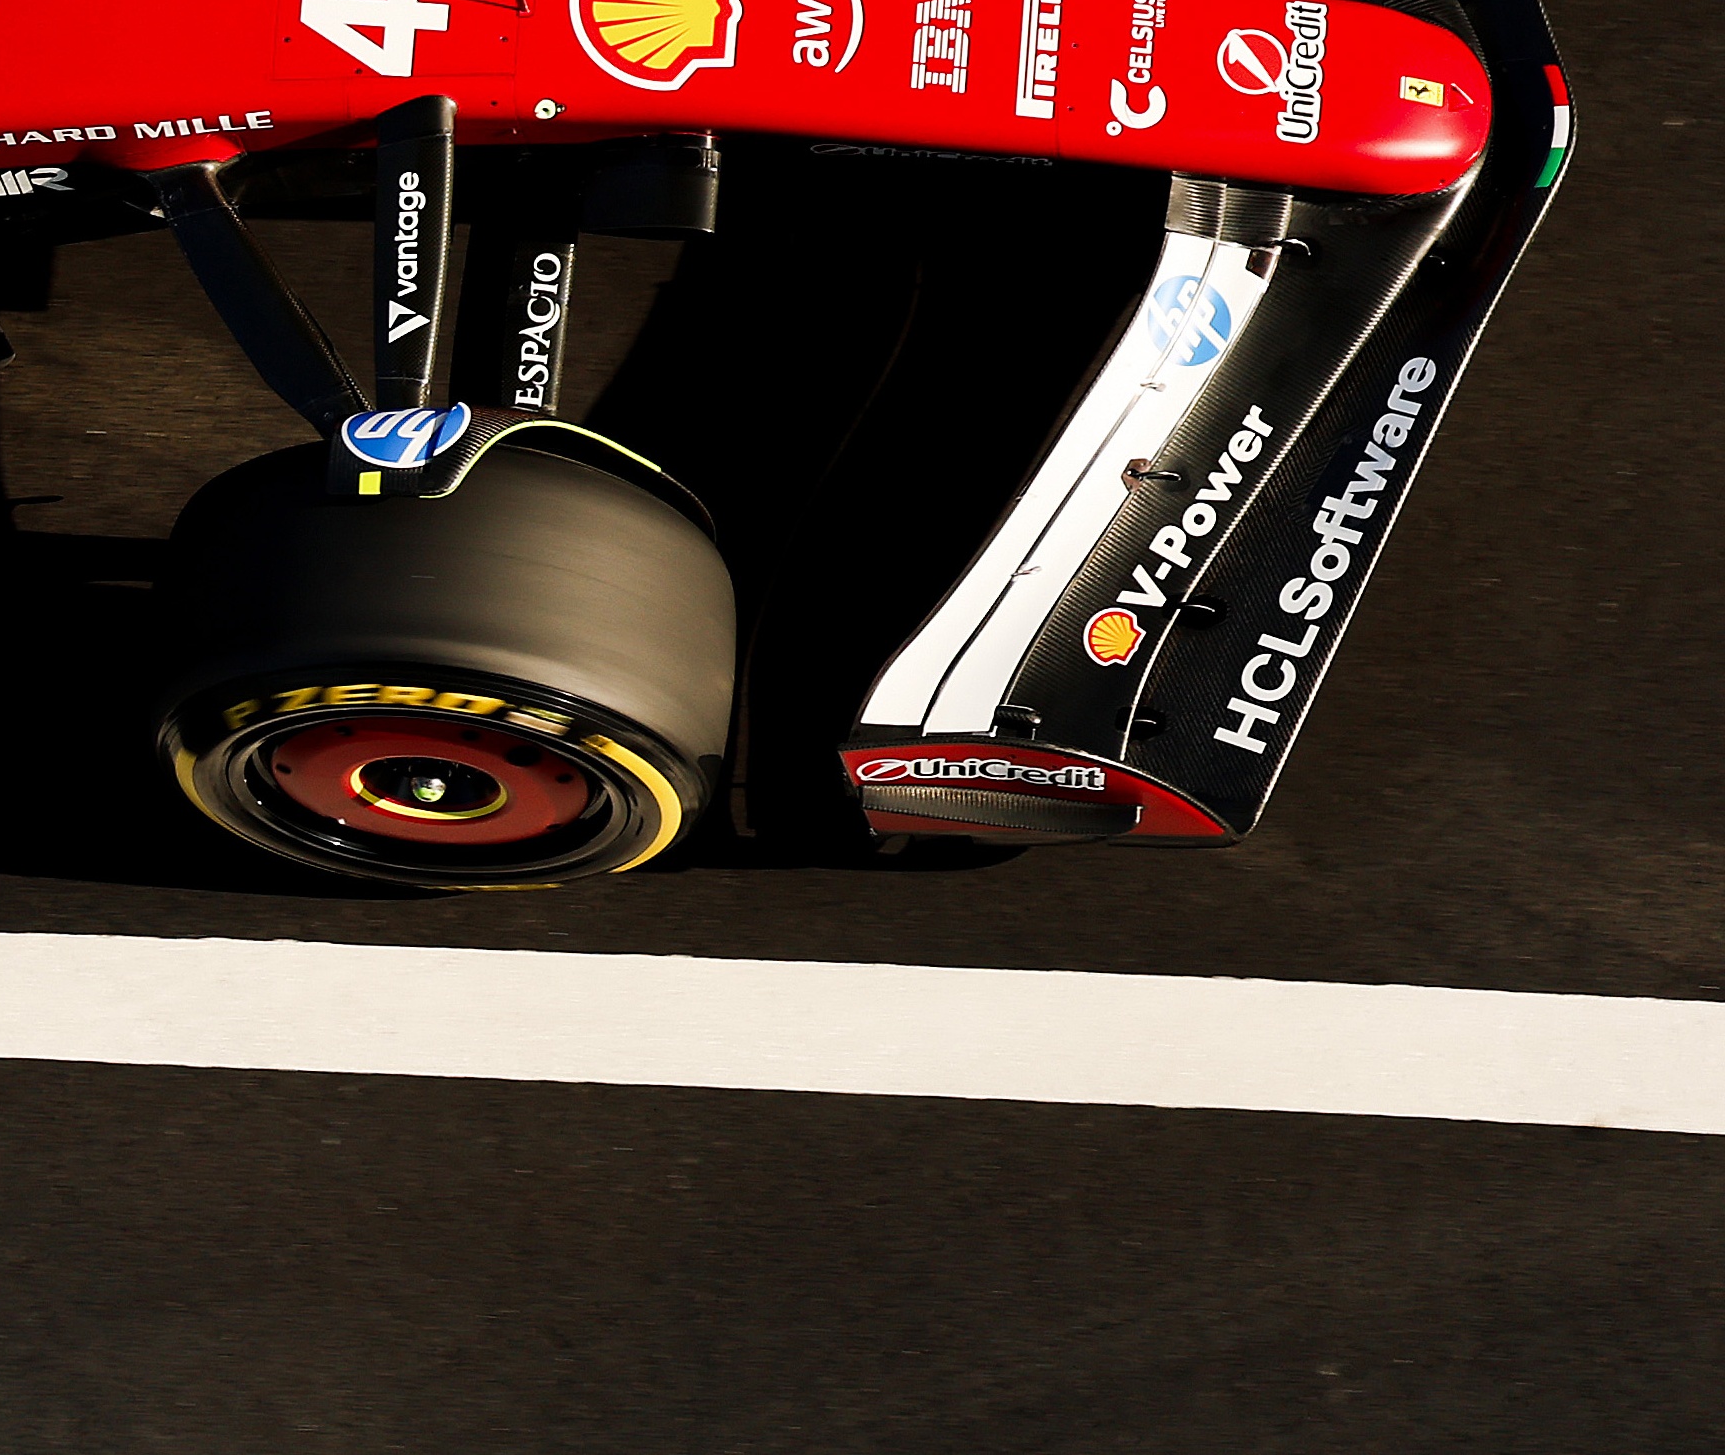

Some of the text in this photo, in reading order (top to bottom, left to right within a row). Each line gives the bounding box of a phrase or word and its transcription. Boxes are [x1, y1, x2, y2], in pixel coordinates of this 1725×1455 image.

[133, 110, 274, 140] MILLE
[1278, 2, 1327, 142] UniCredit
[397, 170, 427, 299] vantage
[514, 252, 563, 409] ESPACIO
[1117, 404, 1274, 609] V-Power
[1212, 355, 1437, 754] HCLSoftware
[912, 757, 1106, 791] UniCredit
